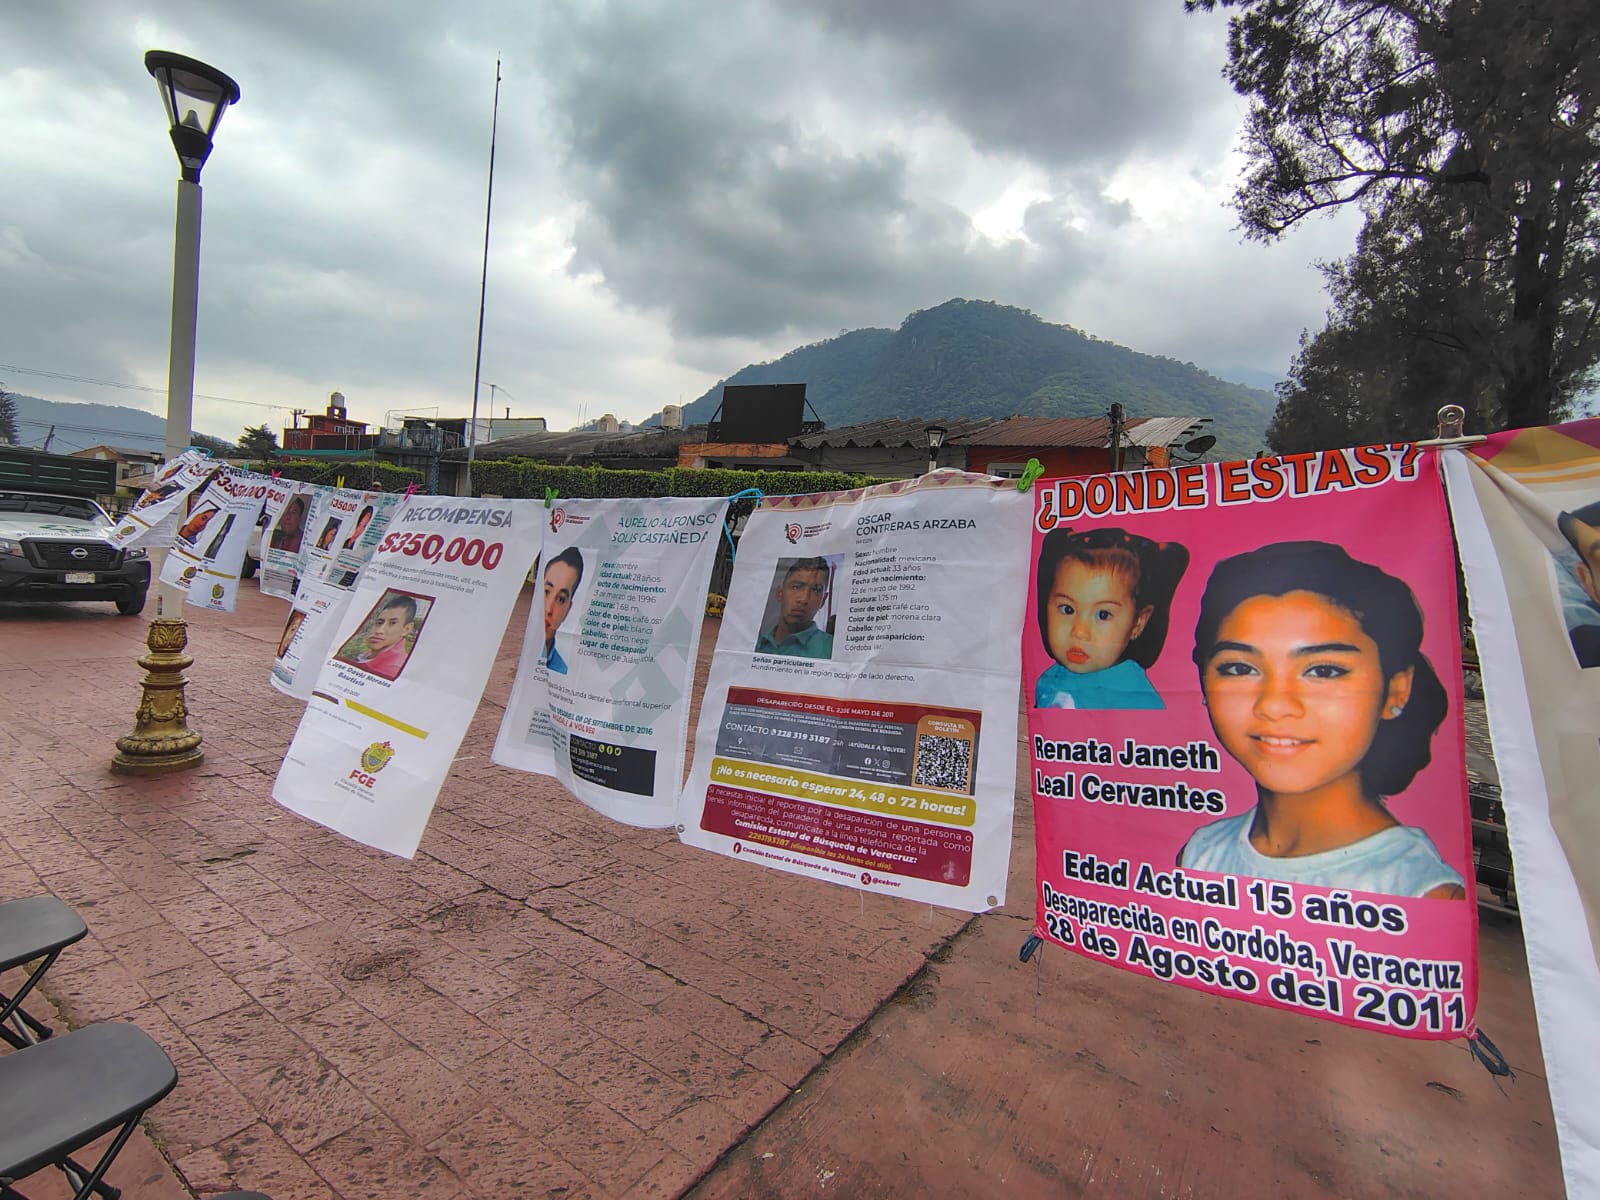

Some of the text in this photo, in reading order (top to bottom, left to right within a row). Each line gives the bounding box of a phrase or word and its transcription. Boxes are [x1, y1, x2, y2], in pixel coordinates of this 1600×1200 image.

[1038, 443, 1420, 530] ¿DONDE ESTAS?
[402, 507, 513, 528] RECOMPENSA
[618, 513, 717, 528] AURELIO ALFONSO
[858, 513, 891, 525] OSCAR
[856, 519, 976, 536] CONTRERAS ARZABA
[612, 532, 637, 543] SOLIS
[377, 531, 504, 571] $350,000
[621, 583, 666, 593] nacimiento:
[852, 576, 870, 585] Fecha
[638, 595, 656, 603] 1996
[602, 611, 611, 619] de
[613, 613, 630, 621] ojos:
[876, 633, 925, 641] desaparición:
[752, 664, 792, 674] Hundimiento
[811, 669, 832, 678] región
[868, 671, 884, 680] lado
[773, 659, 815, 668] particulares:
[642, 702, 672, 711] superior,
[757, 697, 803, 709] DESAPARECIDO
[804, 703, 825, 711] DESDE
[827, 705, 835, 713] EL
[851, 708, 870, 716] MAYO
[625, 724, 636, 732] DE
[636, 727, 653, 735] 2016
[726, 723, 830, 744] CONTACTO 228 319 3187
[928, 720, 957, 729] CONSULTA
[882, 746, 906, 754] VOLVER!
[1035, 735, 1218, 770] Renata Janeth
[349, 769, 376, 788] FGE
[717, 766, 966, 816] ¡No es necesario esperar 24, 48 o 72 horas!
[1036, 771, 1225, 813] Leal Cervantes
[716, 788, 744, 799] necesitas
[768, 796, 775, 805] el
[776, 799, 805, 811] reporte
[808, 806, 822, 817] por
[825, 808, 831, 817] la
[834, 811, 882, 828] desaparición
[886, 821, 898, 830] de
[902, 824, 919, 833] una
[923, 827, 961, 840] persona
[727, 799, 766, 812] información
[768, 807, 779, 815] del
[783, 811, 820, 824] paradero
[835, 822, 850, 830] una
[854, 825, 887, 838] persona
[892, 832, 938, 847] reportada
[943, 842, 970, 852] como
[735, 819, 918, 864] Comisión Estatal de Búsqueda de Veracruz:
[831, 829, 837, 838] la
[860, 836, 902, 852] telefónica
[904, 844, 916, 854] de
[919, 845, 926, 855] la
[743, 846, 765, 856] Comisión
[765, 852, 784, 862] Estatal
[792, 856, 821, 869] Búsqueda
[831, 867, 856, 879] Veracruz
[1064, 852, 1407, 933] Edad Actual 15 años
[1042, 882, 1461, 990] Desaparecida en Cordoba, Veracruz
[1046, 914, 1465, 1031] 28 de Agosto del 2011
